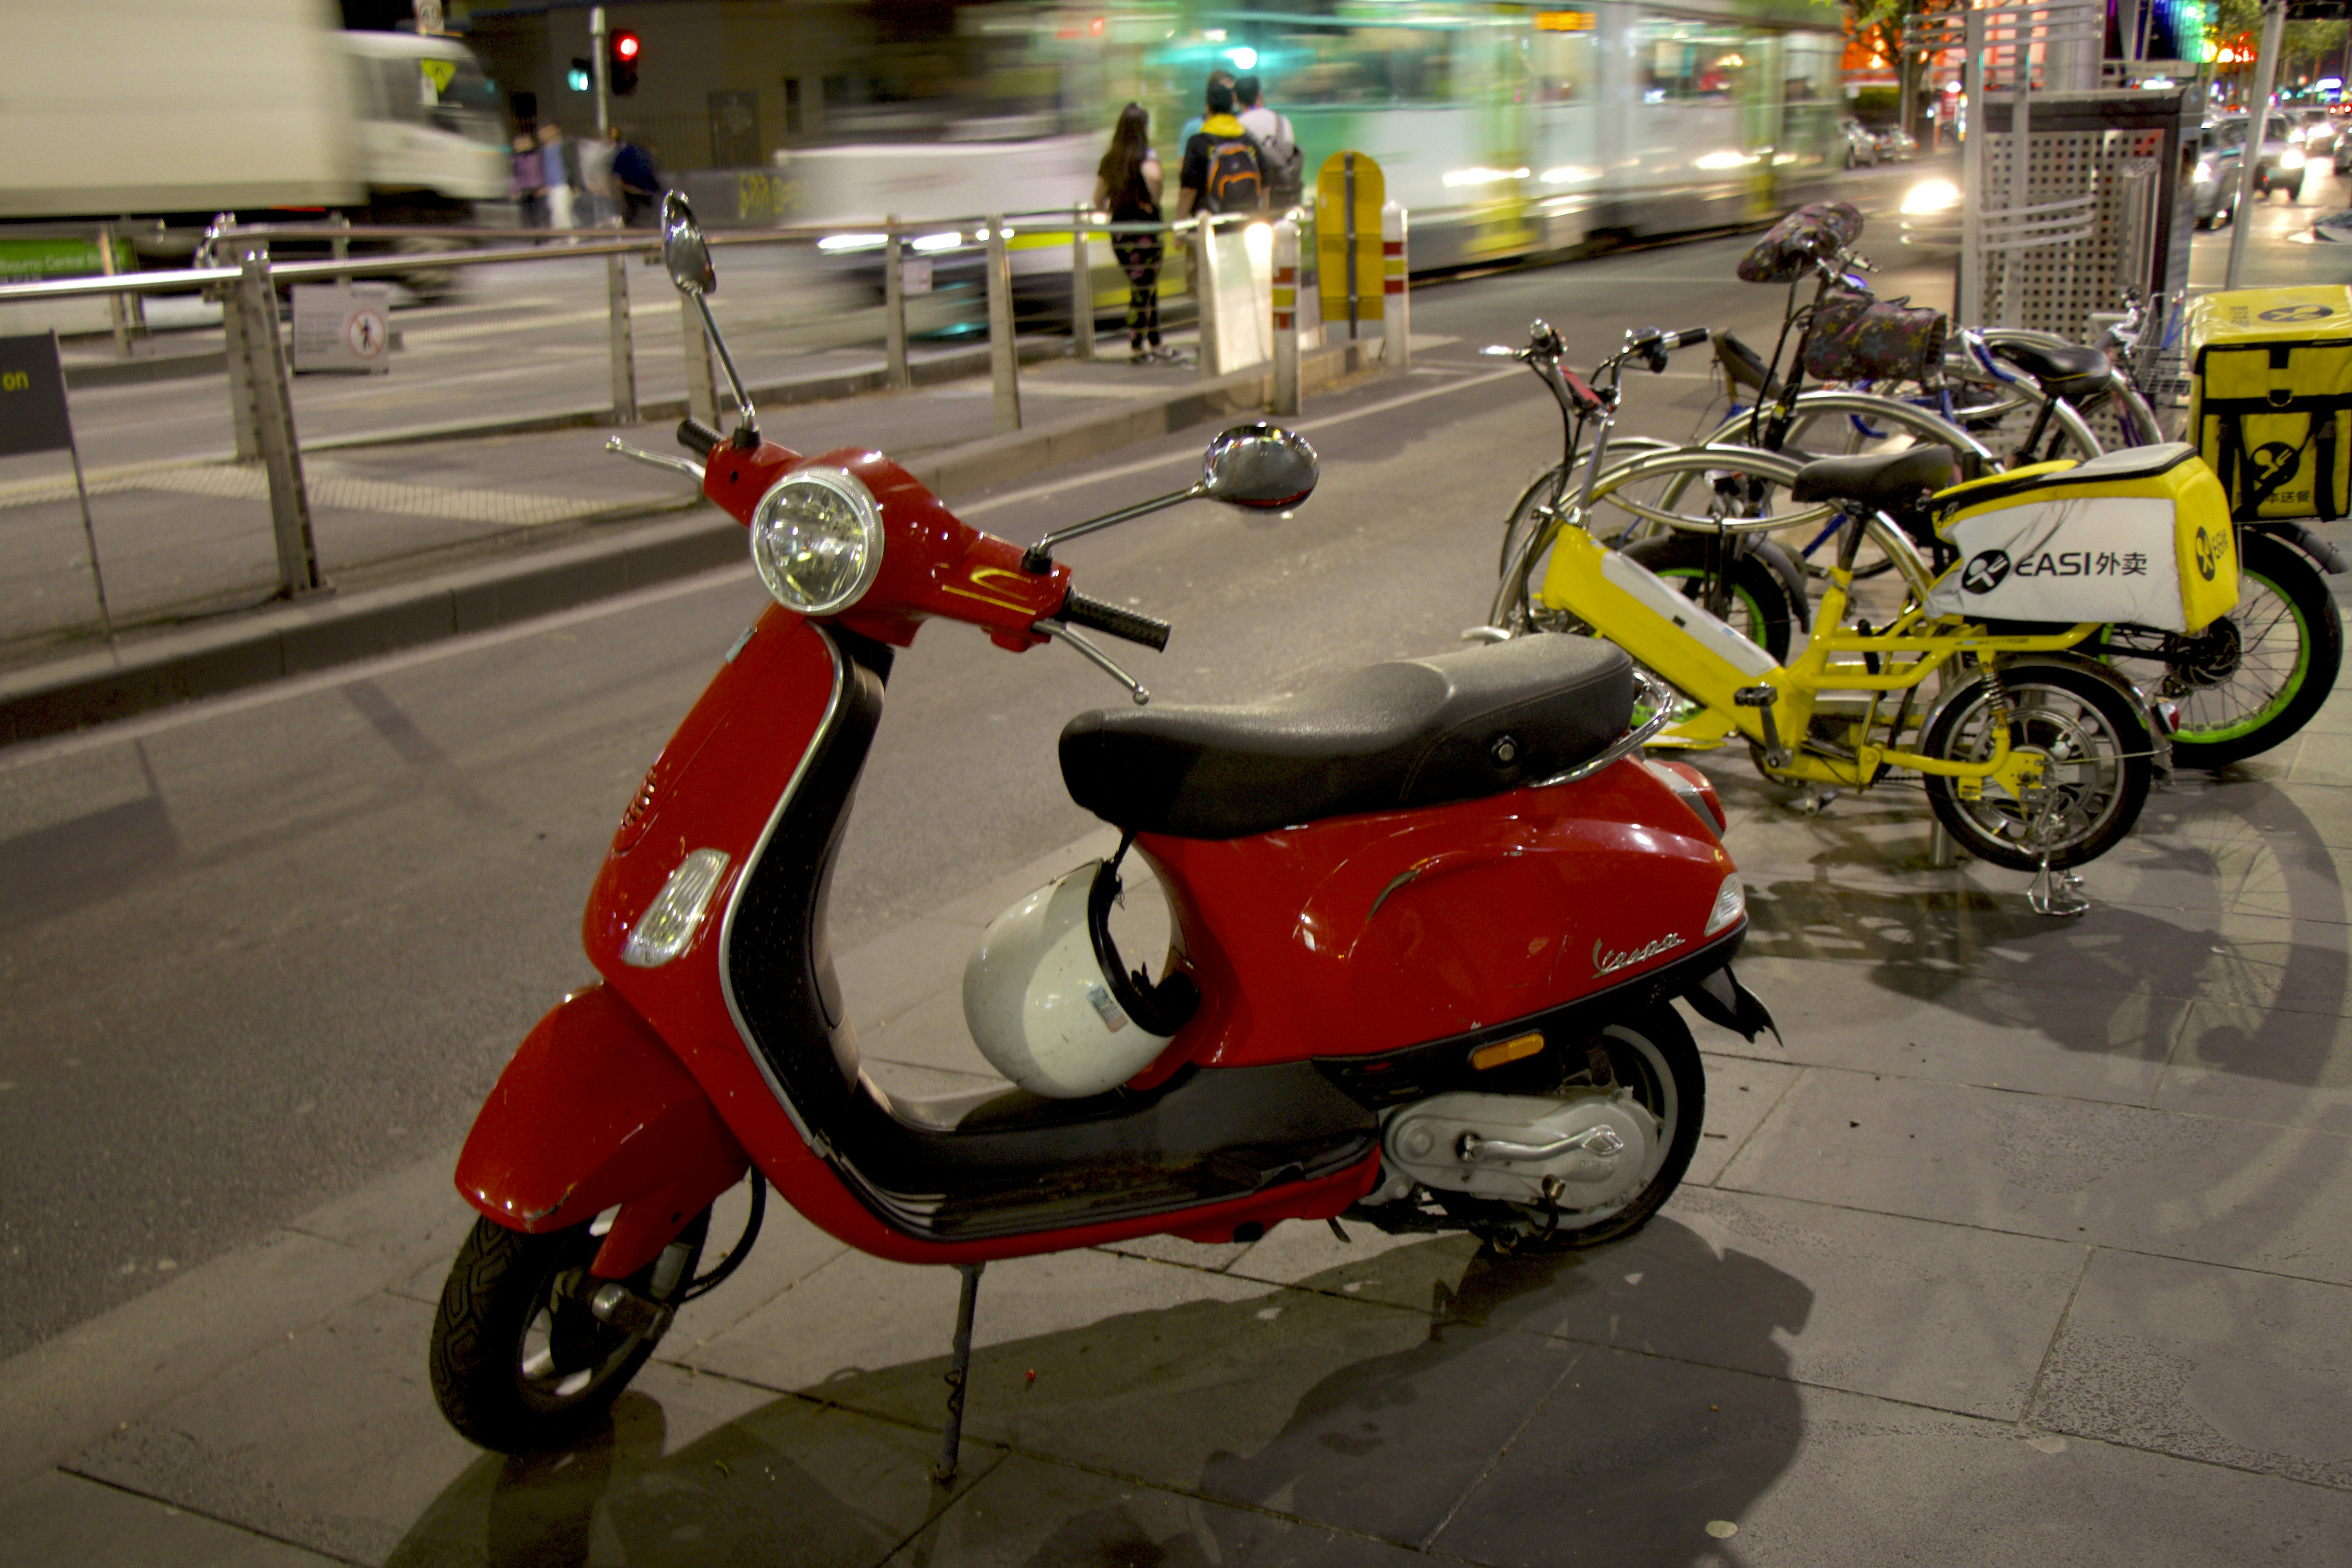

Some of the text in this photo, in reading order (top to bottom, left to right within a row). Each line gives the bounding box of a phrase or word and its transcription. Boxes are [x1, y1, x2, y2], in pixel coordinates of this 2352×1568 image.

[2, 370, 29, 392] on
[2016, 552, 2147, 576] EASI 外卖
[1592, 933, 1686, 979] Vespa
